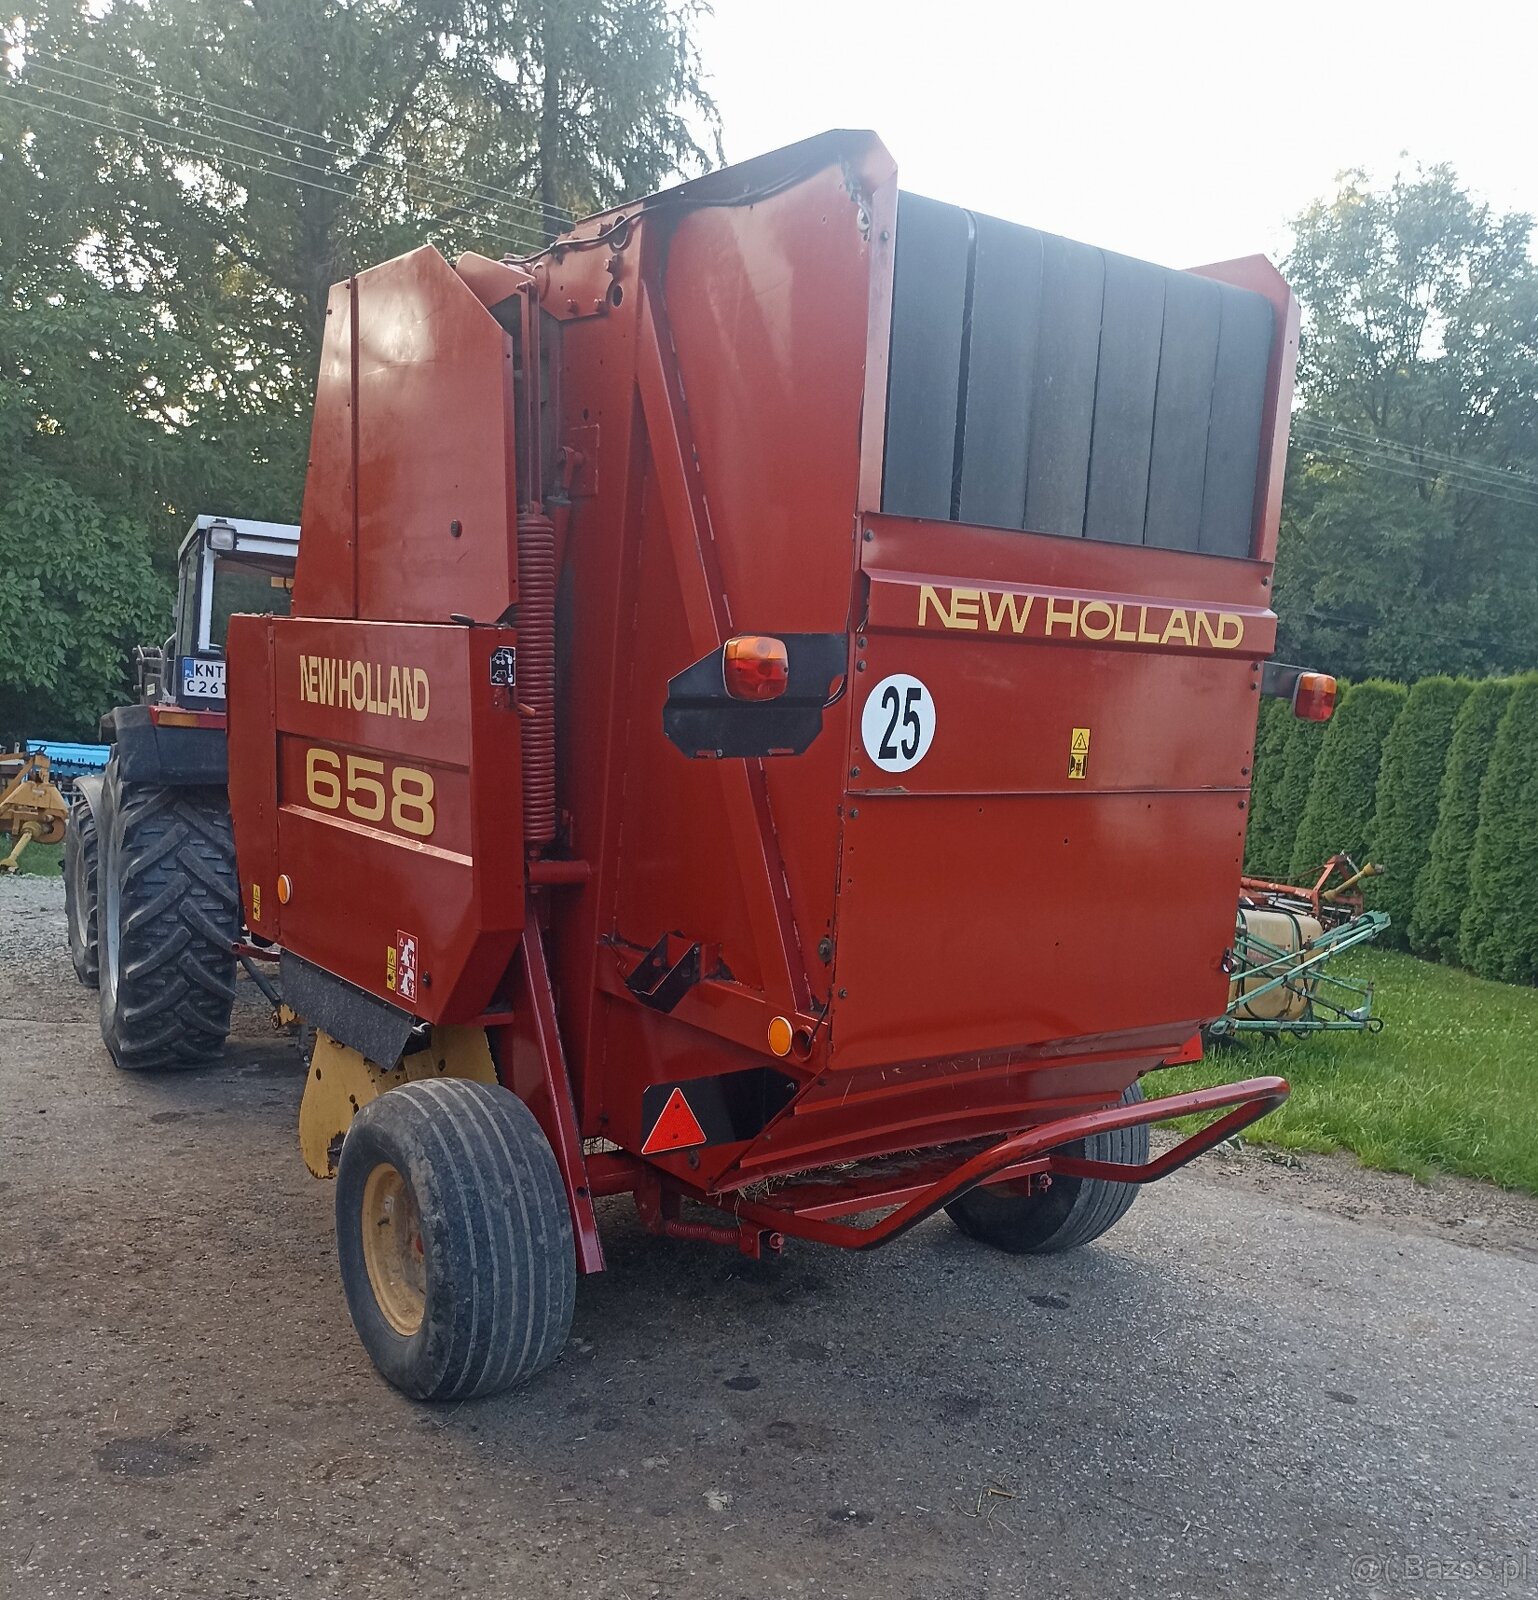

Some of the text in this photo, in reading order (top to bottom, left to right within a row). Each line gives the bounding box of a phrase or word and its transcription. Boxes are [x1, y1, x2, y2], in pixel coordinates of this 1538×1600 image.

[917, 585, 1244, 649] NEW HOLLAND
[186, 680, 226, 694] C26
[195, 663, 224, 678] KNT
[299, 655, 430, 722] NEW HOLLAND
[878, 686, 921, 760] 25
[306, 748, 435, 836] 658
